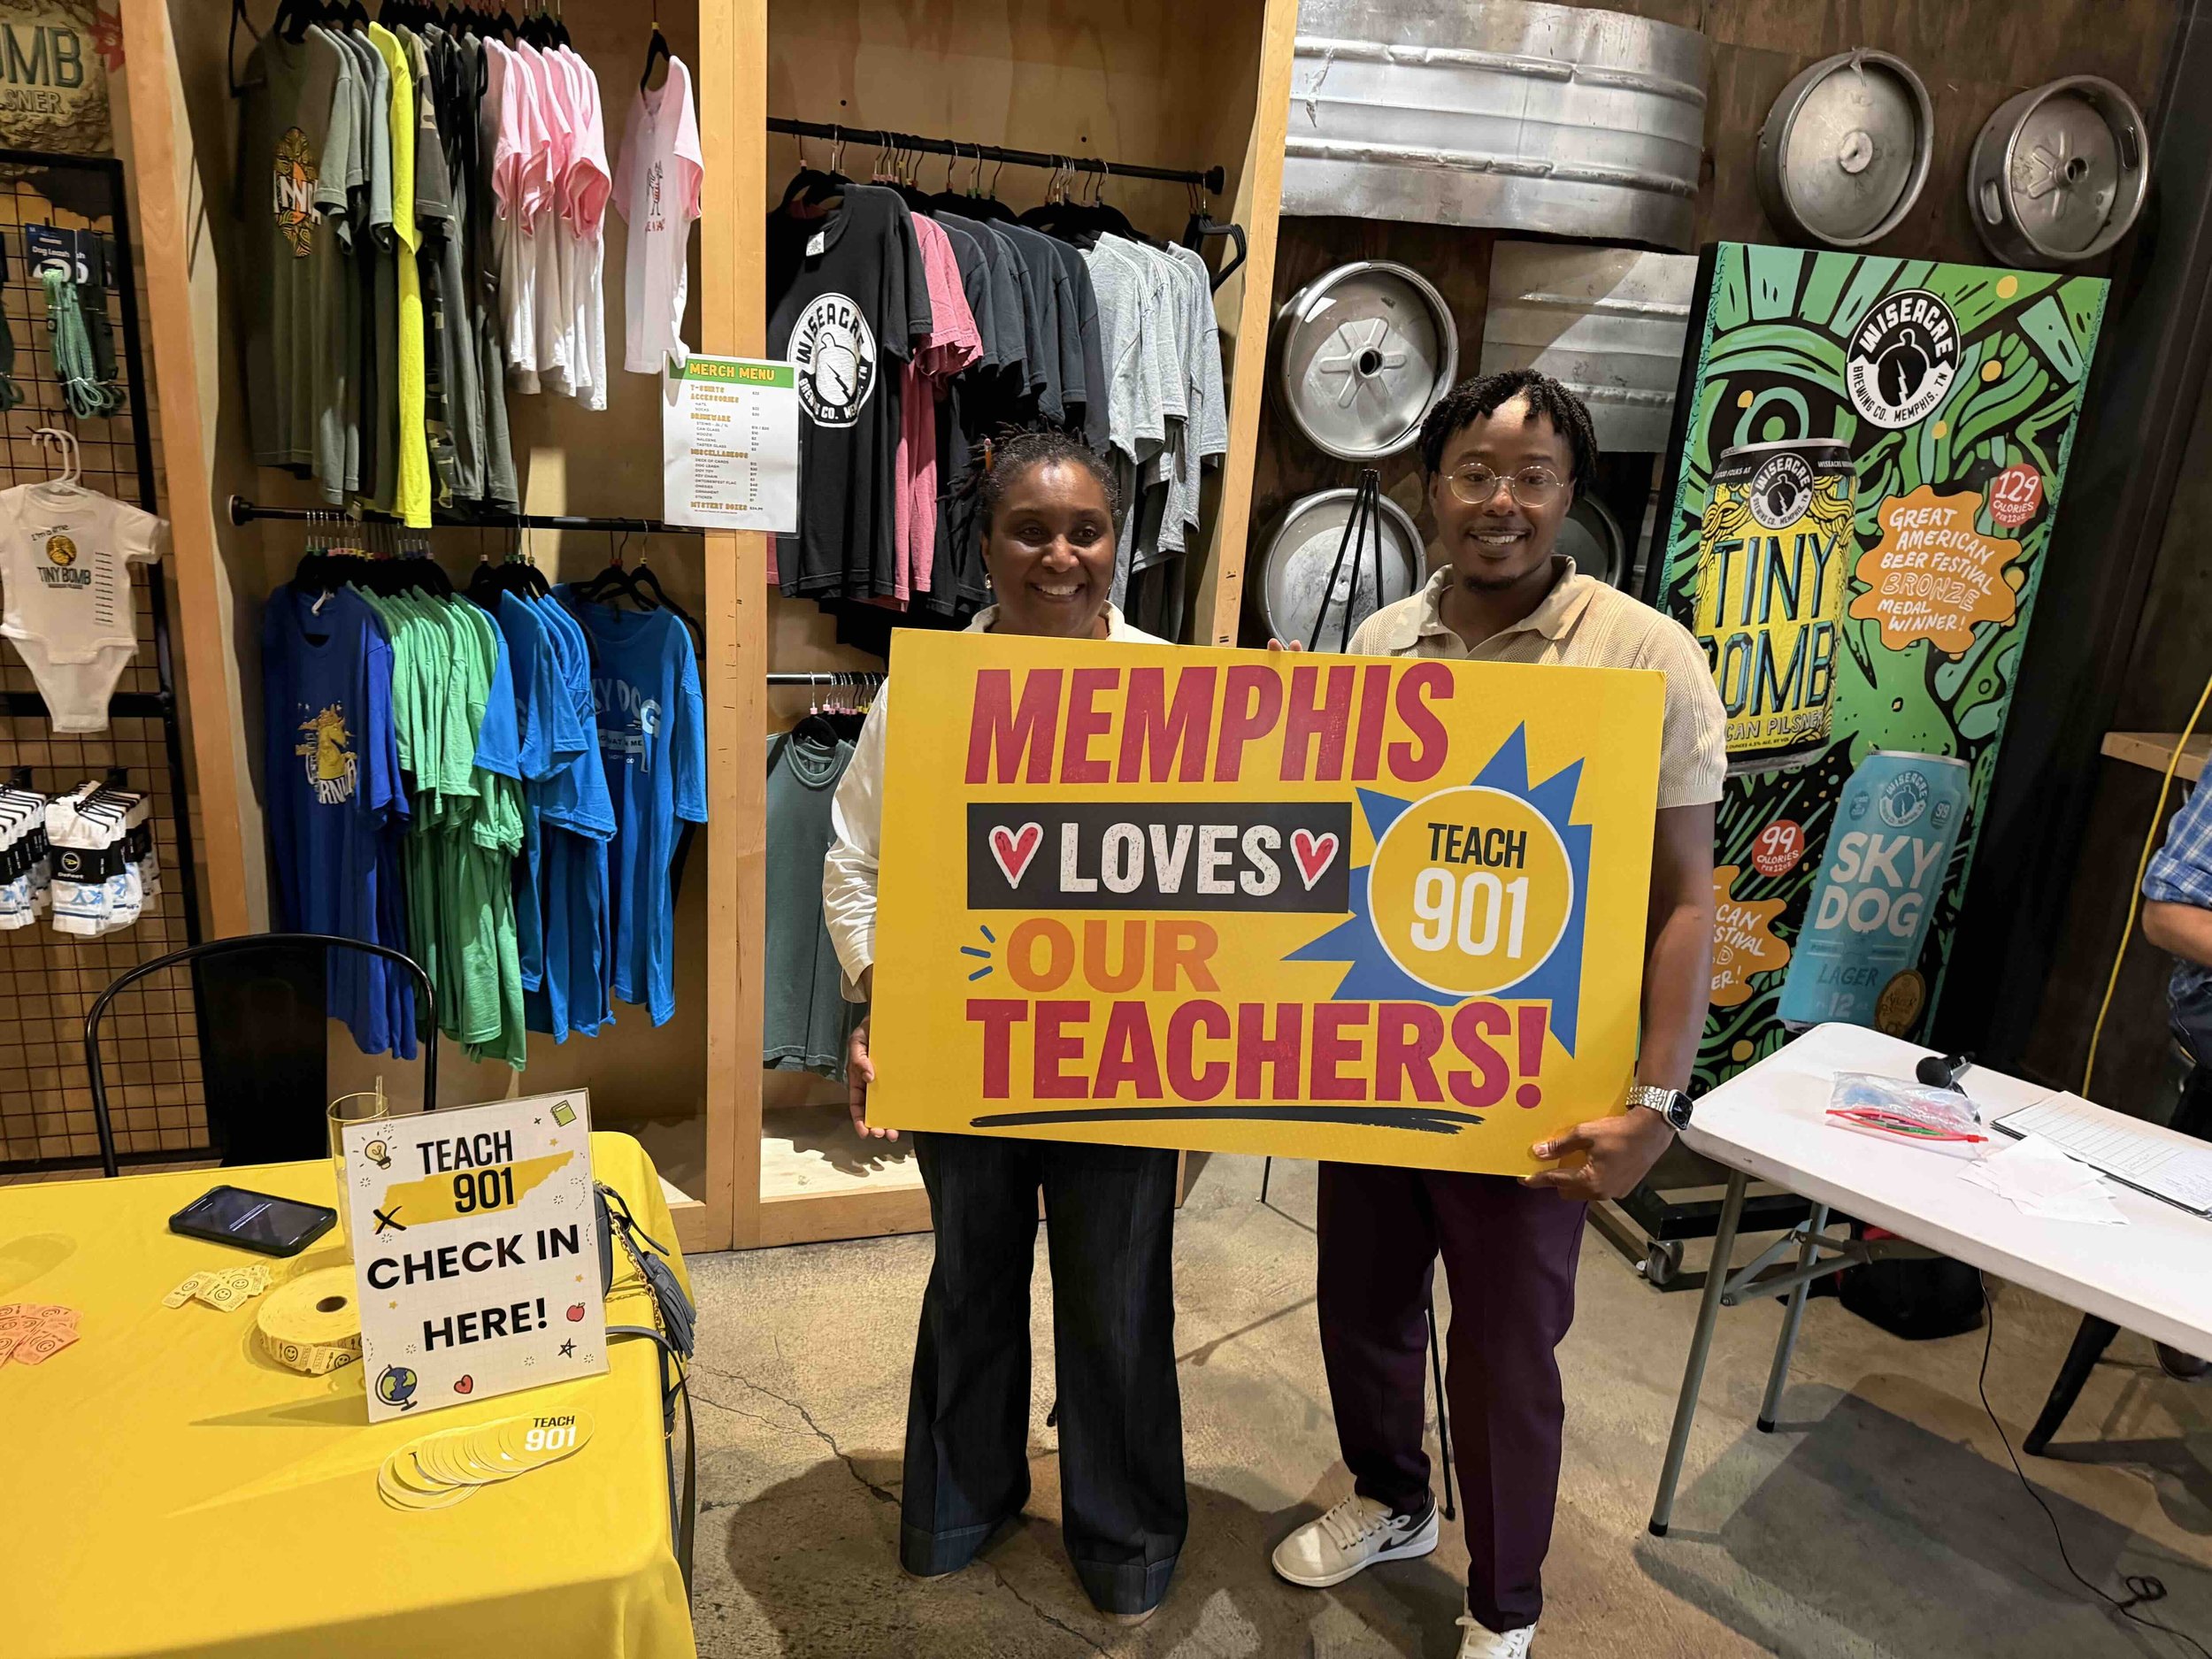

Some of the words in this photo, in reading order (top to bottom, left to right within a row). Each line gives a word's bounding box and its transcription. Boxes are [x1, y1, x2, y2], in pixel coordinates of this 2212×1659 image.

[0, 23, 83, 88] MB
[1859, 297, 1954, 358] WISEACRE
[690, 363, 735, 378] MERCH
[740, 367, 775, 380] MENU
[1853, 365, 1874, 411] BREWING
[1873, 405, 1886, 421] CO.
[1934, 373, 1948, 388] TN
[821, 406, 839, 420] CO.
[691, 449, 749, 458] MISCELLANEOUS
[1755, 457, 1810, 491] WISEACRE
[1994, 471, 2039, 503] 129
[1889, 507, 1958, 531] GREAT
[1993, 500, 2034, 513] CALORIES
[1896, 530, 1994, 565] AMERICAN
[36, 566, 60, 583] TINY
[62, 568, 92, 585] BOMB
[1714, 534, 1839, 627] TINY
[1880, 552, 1929, 569] BEER
[1931, 552, 1994, 595] FESTIVAL
[1878, 599, 1932, 615] MEDAL
[1880, 572, 1980, 612] BRONZE
[1887, 612, 1965, 632] WINNER!
[964, 662, 1455, 785] MEMPHIS
[1725, 720, 1761, 741] CAN
[1767, 710, 1824, 735] PILSNER
[1886, 772, 1928, 799] WISEACRE
[1427, 821, 1527, 871] TEACH
[1756, 849, 1800, 864] CALORIES
[1762, 826, 1796, 856] 99
[1060, 821, 1283, 897] LOVES
[1830, 831, 1944, 888] SKY
[1411, 867, 1528, 959] 901
[1714, 903, 1763, 931] CAN
[1815, 884, 1924, 938] DOG
[1006, 918, 1221, 993] OUR
[1714, 926, 1766, 956] STIVAL
[1816, 964, 1879, 987] LAGER
[1828, 992, 1855, 1018] 12
[965, 998, 1548, 1110] TEACHERS!
[416, 1129, 514, 1175] TEACH
[452, 1166, 515, 1214] 901
[367, 1233, 526, 1290] CHECK
[536, 1224, 580, 1261] IN
[422, 1297, 548, 1352] HERE!
[533, 1415, 576, 1428] TEACH
[524, 1426, 577, 1452] 901
